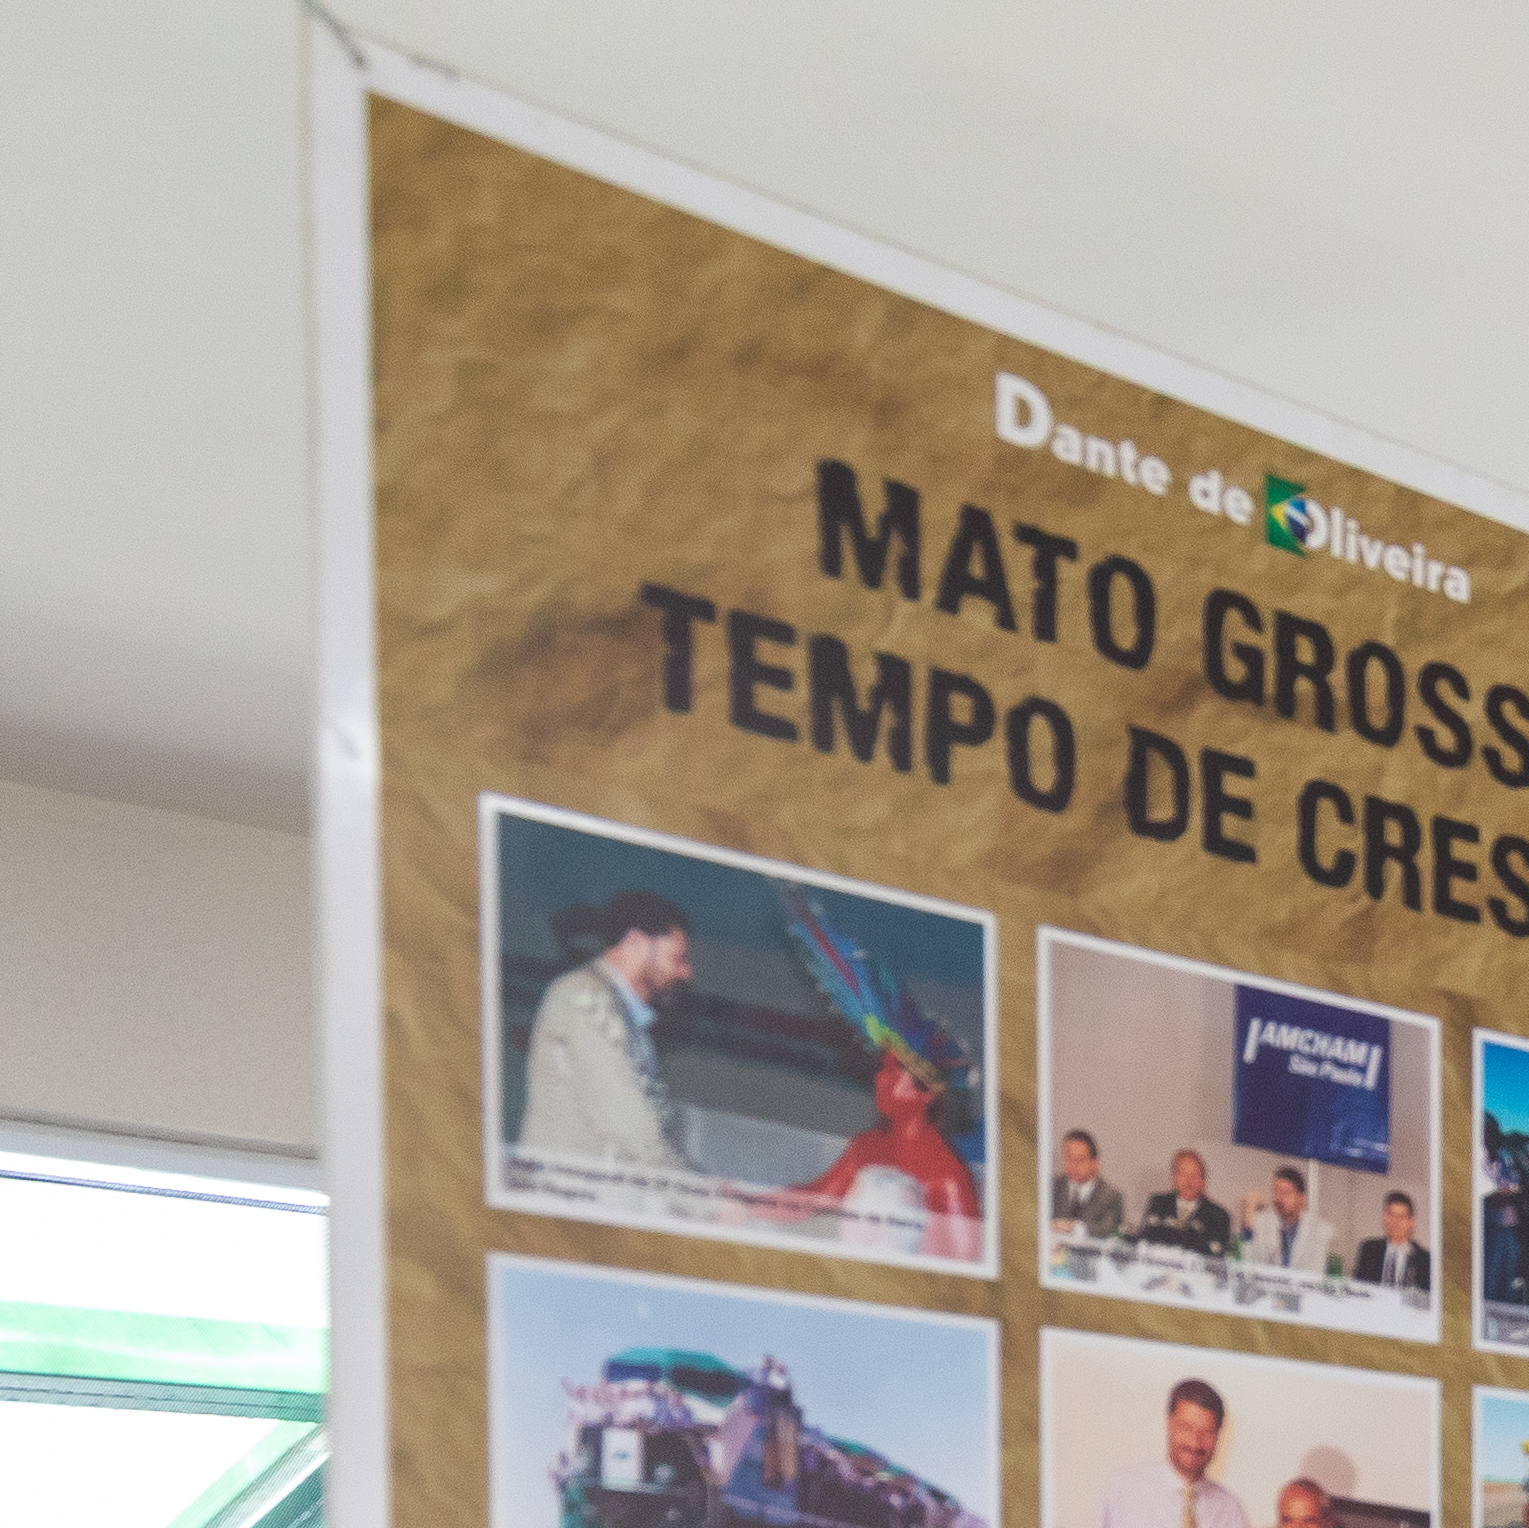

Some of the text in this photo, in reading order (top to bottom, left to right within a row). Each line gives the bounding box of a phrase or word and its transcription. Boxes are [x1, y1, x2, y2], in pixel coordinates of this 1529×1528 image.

[813, 456, 1158, 671] MATO
[994, 370, 1473, 605] Dante de Oliveira
[640, 583, 1077, 815] TEMPO
[1125, 724, 1260, 863] DE
